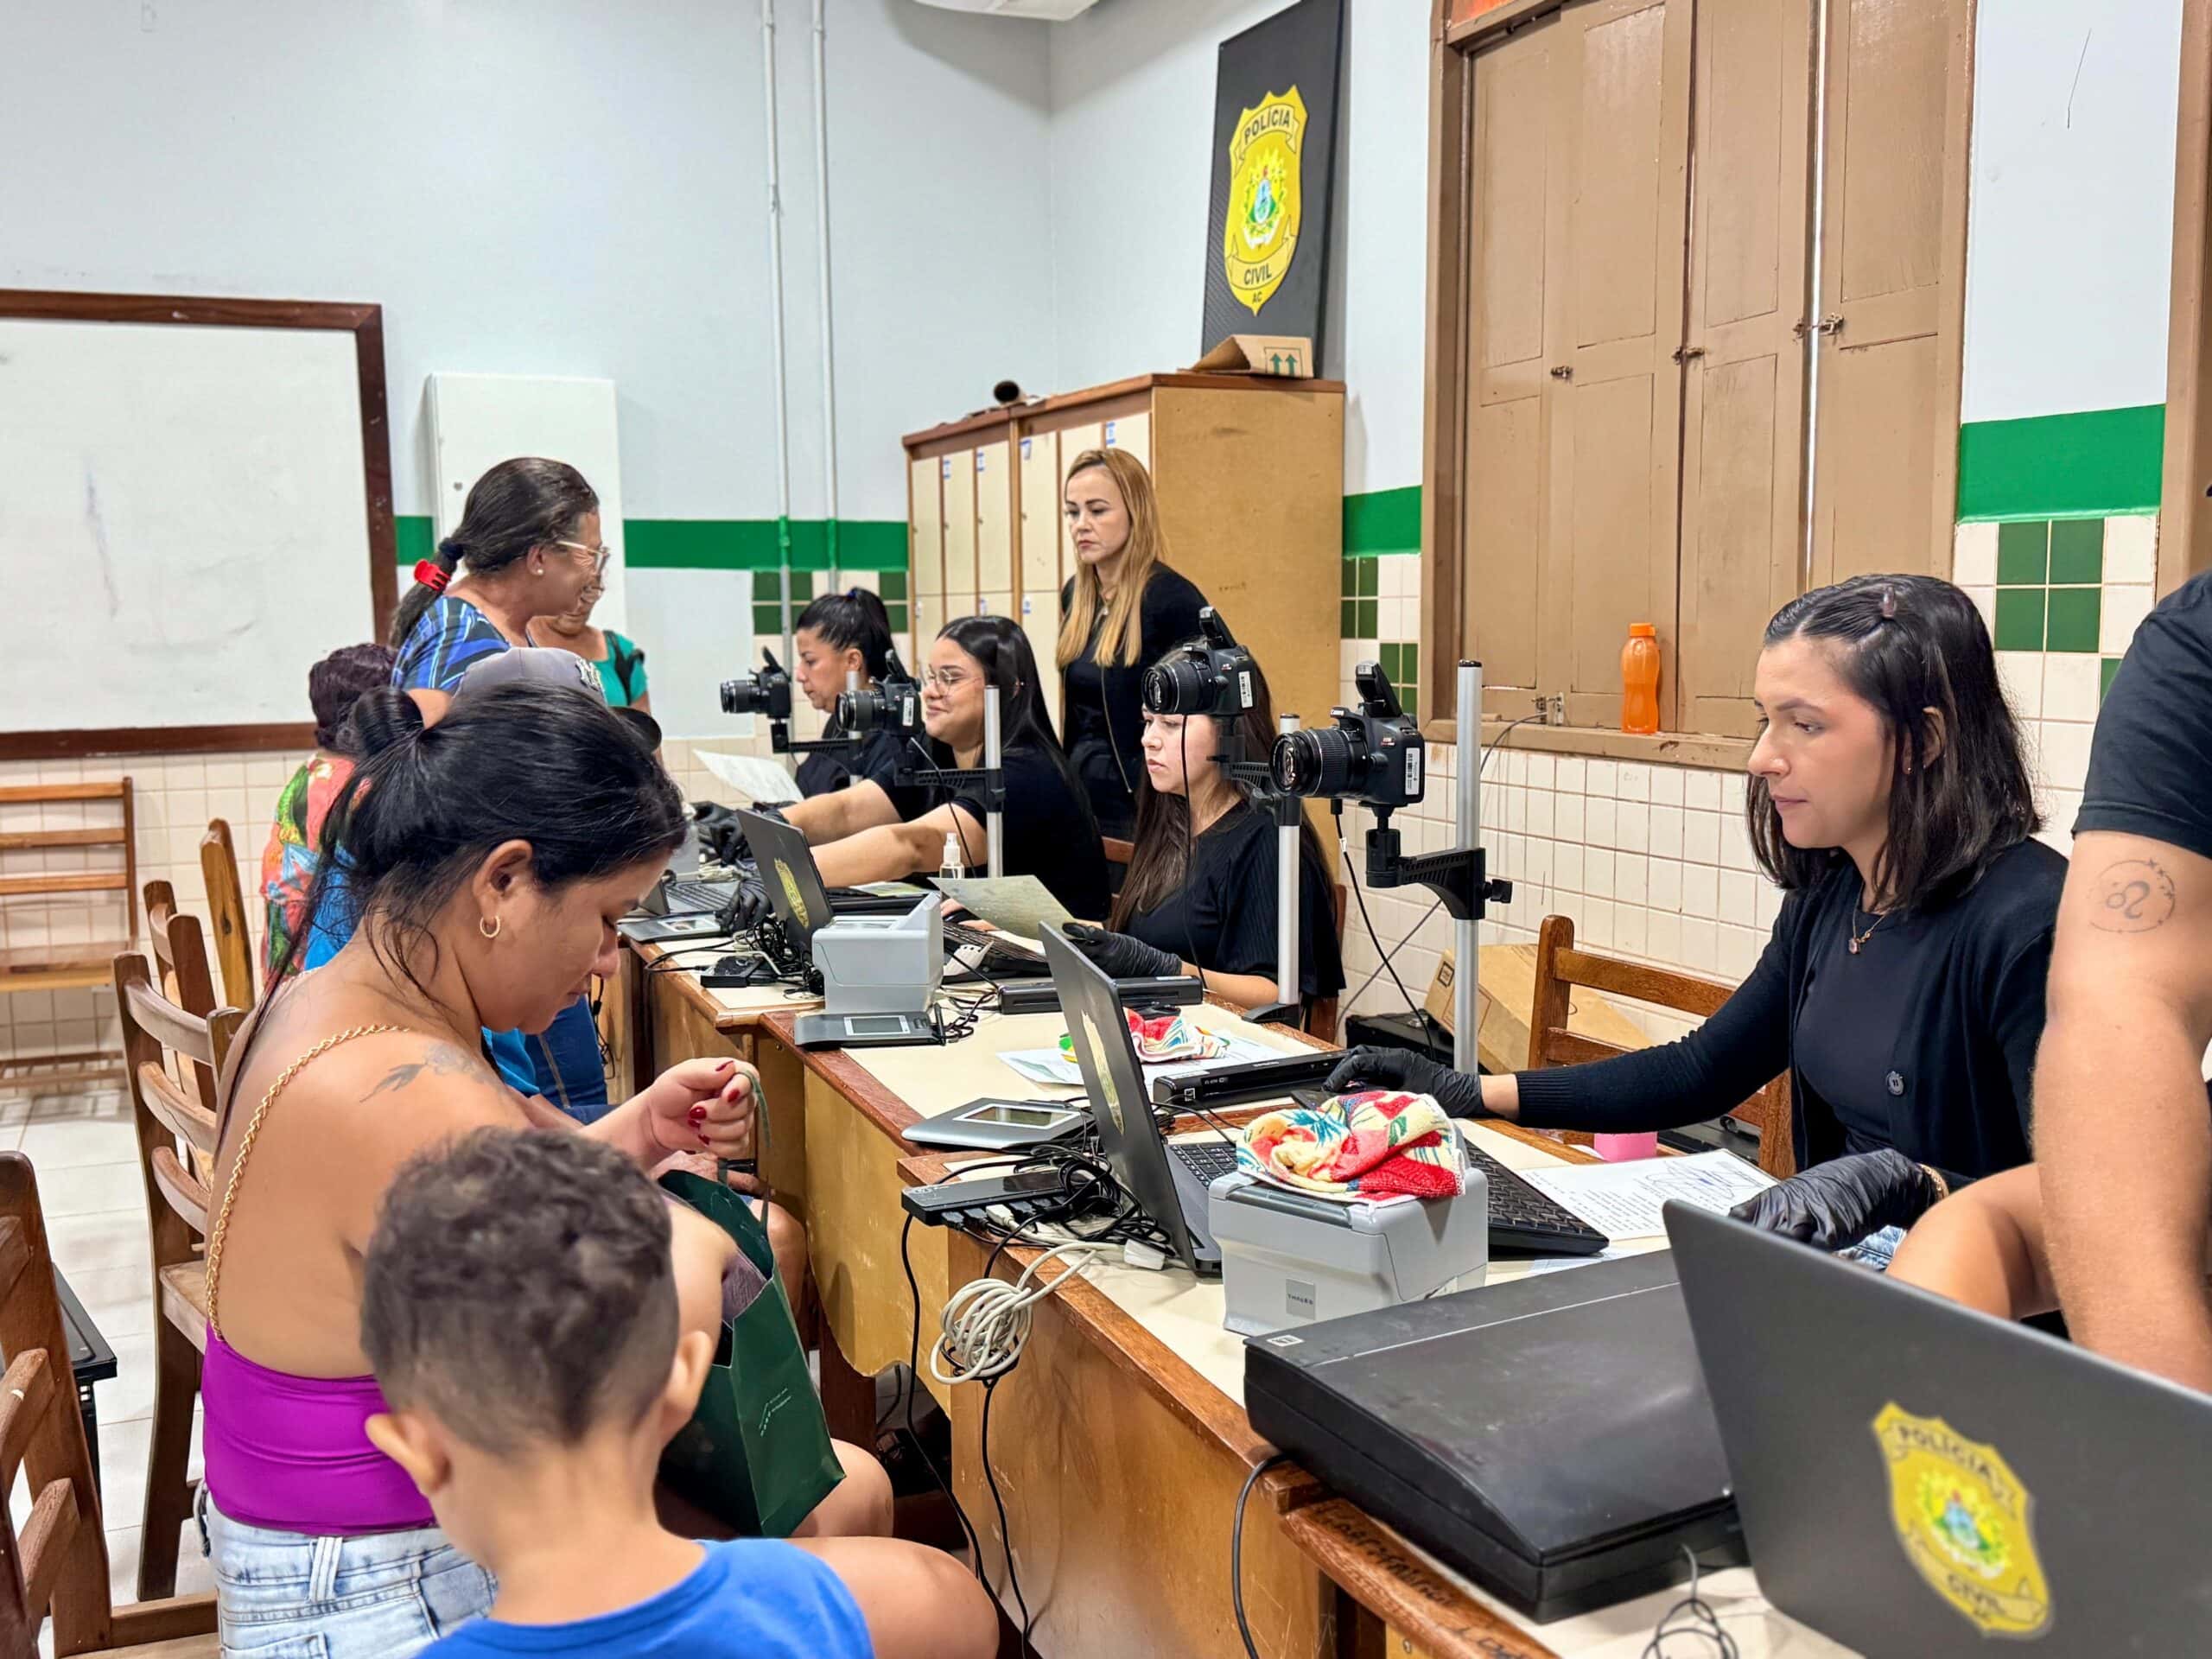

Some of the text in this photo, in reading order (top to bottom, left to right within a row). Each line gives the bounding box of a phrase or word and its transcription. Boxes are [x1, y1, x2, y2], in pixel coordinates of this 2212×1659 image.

[1244, 107, 1290, 145] POLÍCIA
[1244, 263, 1272, 285] CIVIL
[1252, 291, 1262, 304] AC
